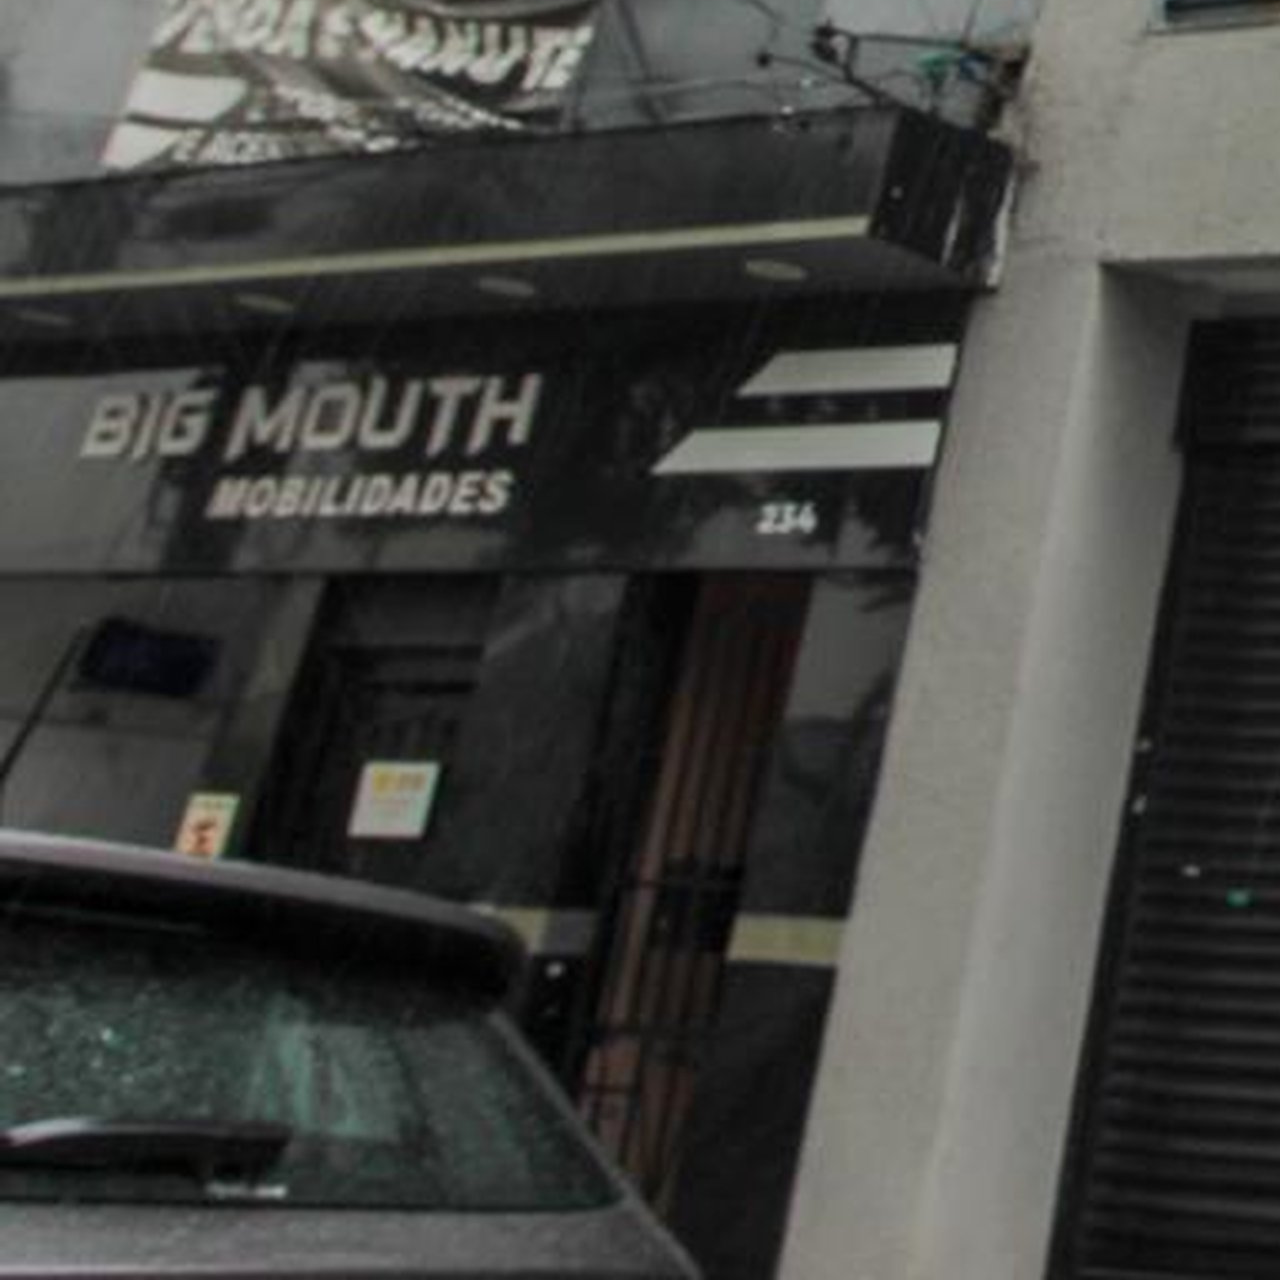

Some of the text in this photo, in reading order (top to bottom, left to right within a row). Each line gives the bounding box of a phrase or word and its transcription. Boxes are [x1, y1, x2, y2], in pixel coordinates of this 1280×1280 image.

[81, 372, 542, 459] BIG MOUTH
[205, 470, 514, 521] MOBILIDADES
